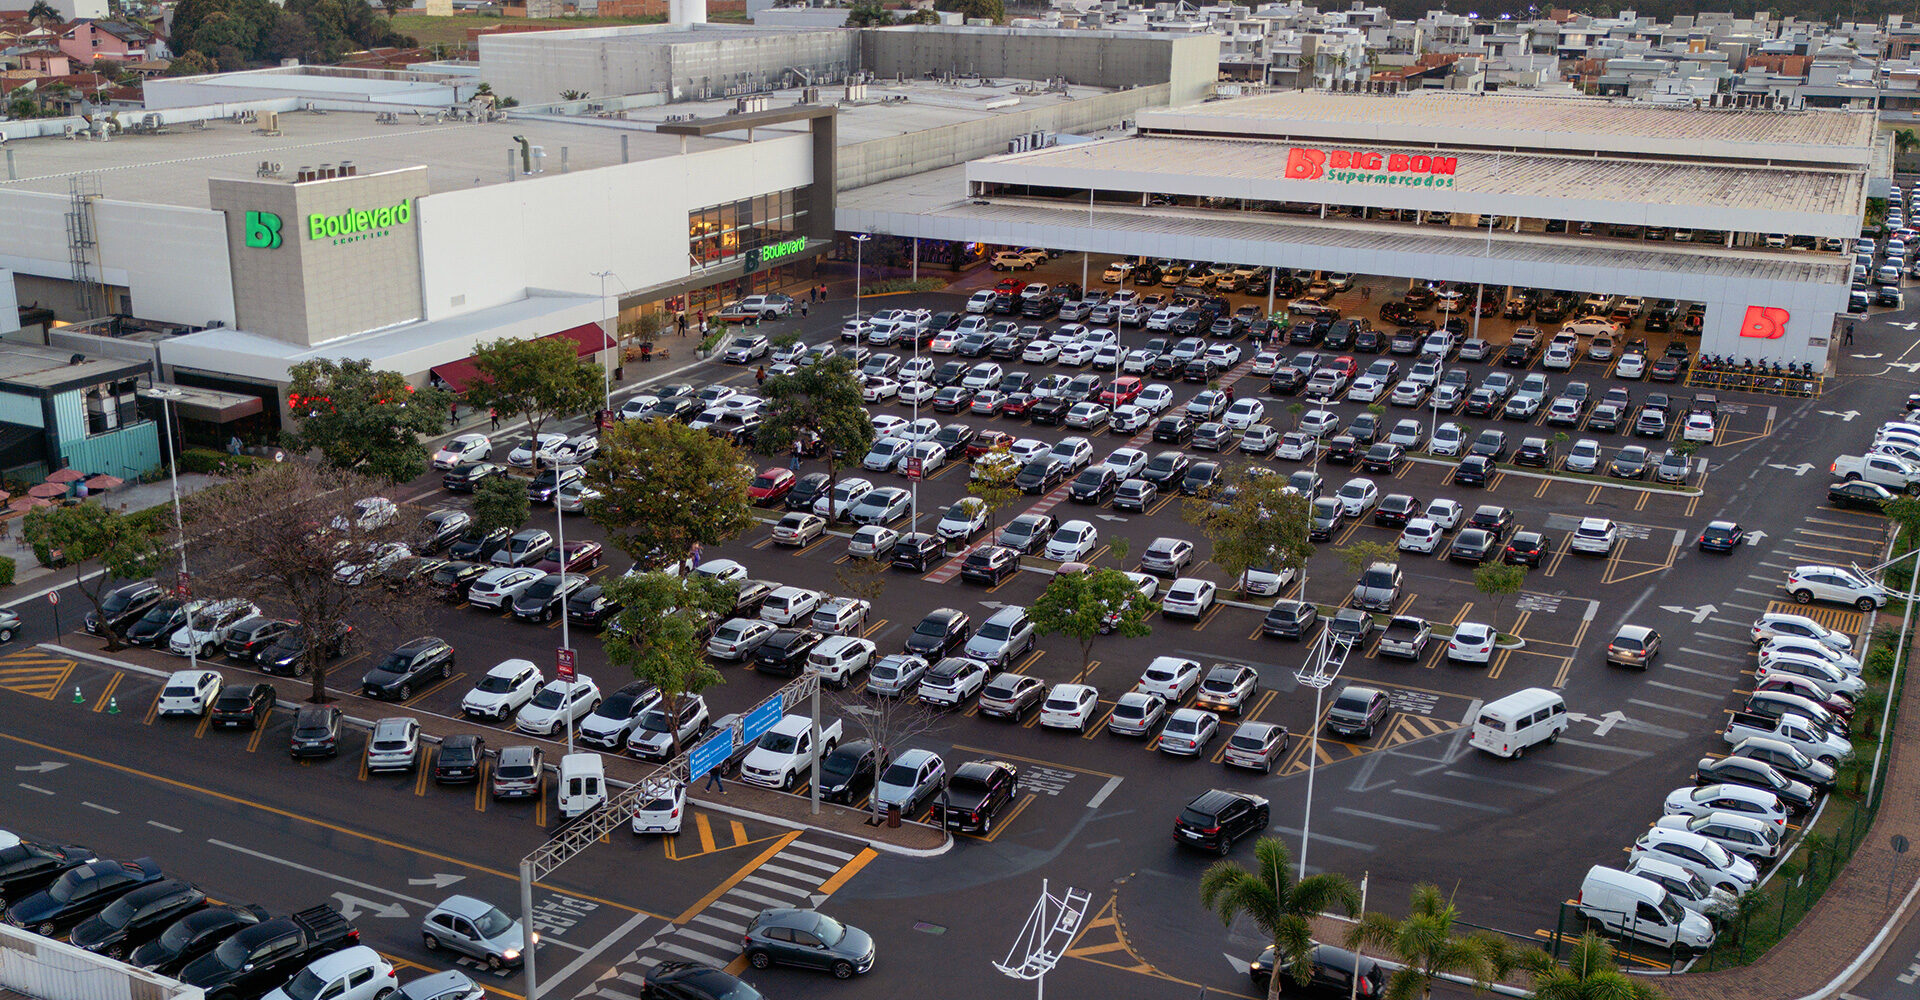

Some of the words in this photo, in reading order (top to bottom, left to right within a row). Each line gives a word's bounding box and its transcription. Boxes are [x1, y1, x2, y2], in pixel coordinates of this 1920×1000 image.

[1329, 150, 1384, 171] BIG
[1387, 153, 1458, 175] BOM
[1328, 169, 1454, 188] Supermercados
[308, 198, 411, 240] Boulevard
[763, 235, 805, 261] Boulevard
